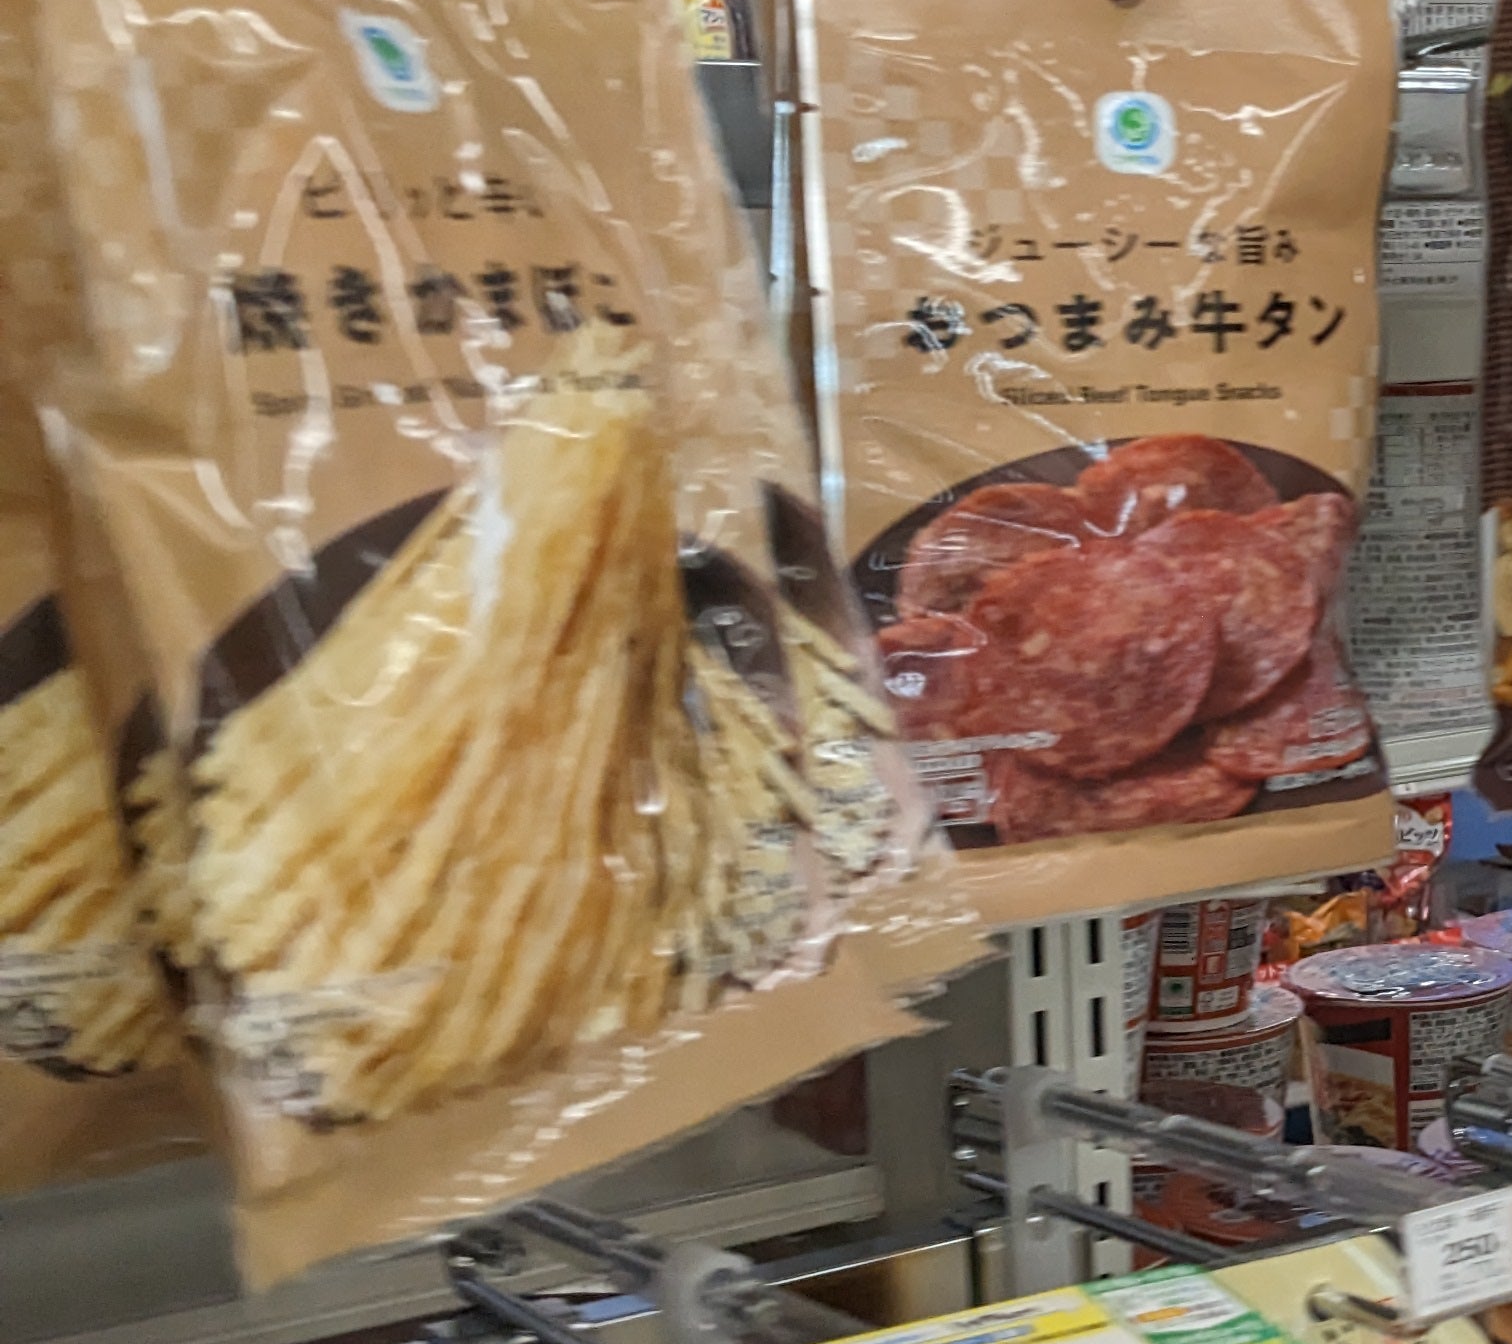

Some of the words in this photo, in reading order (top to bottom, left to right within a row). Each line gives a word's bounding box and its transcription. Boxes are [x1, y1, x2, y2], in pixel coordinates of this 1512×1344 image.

[902, 286, 1347, 354] おつまみ牛タン
